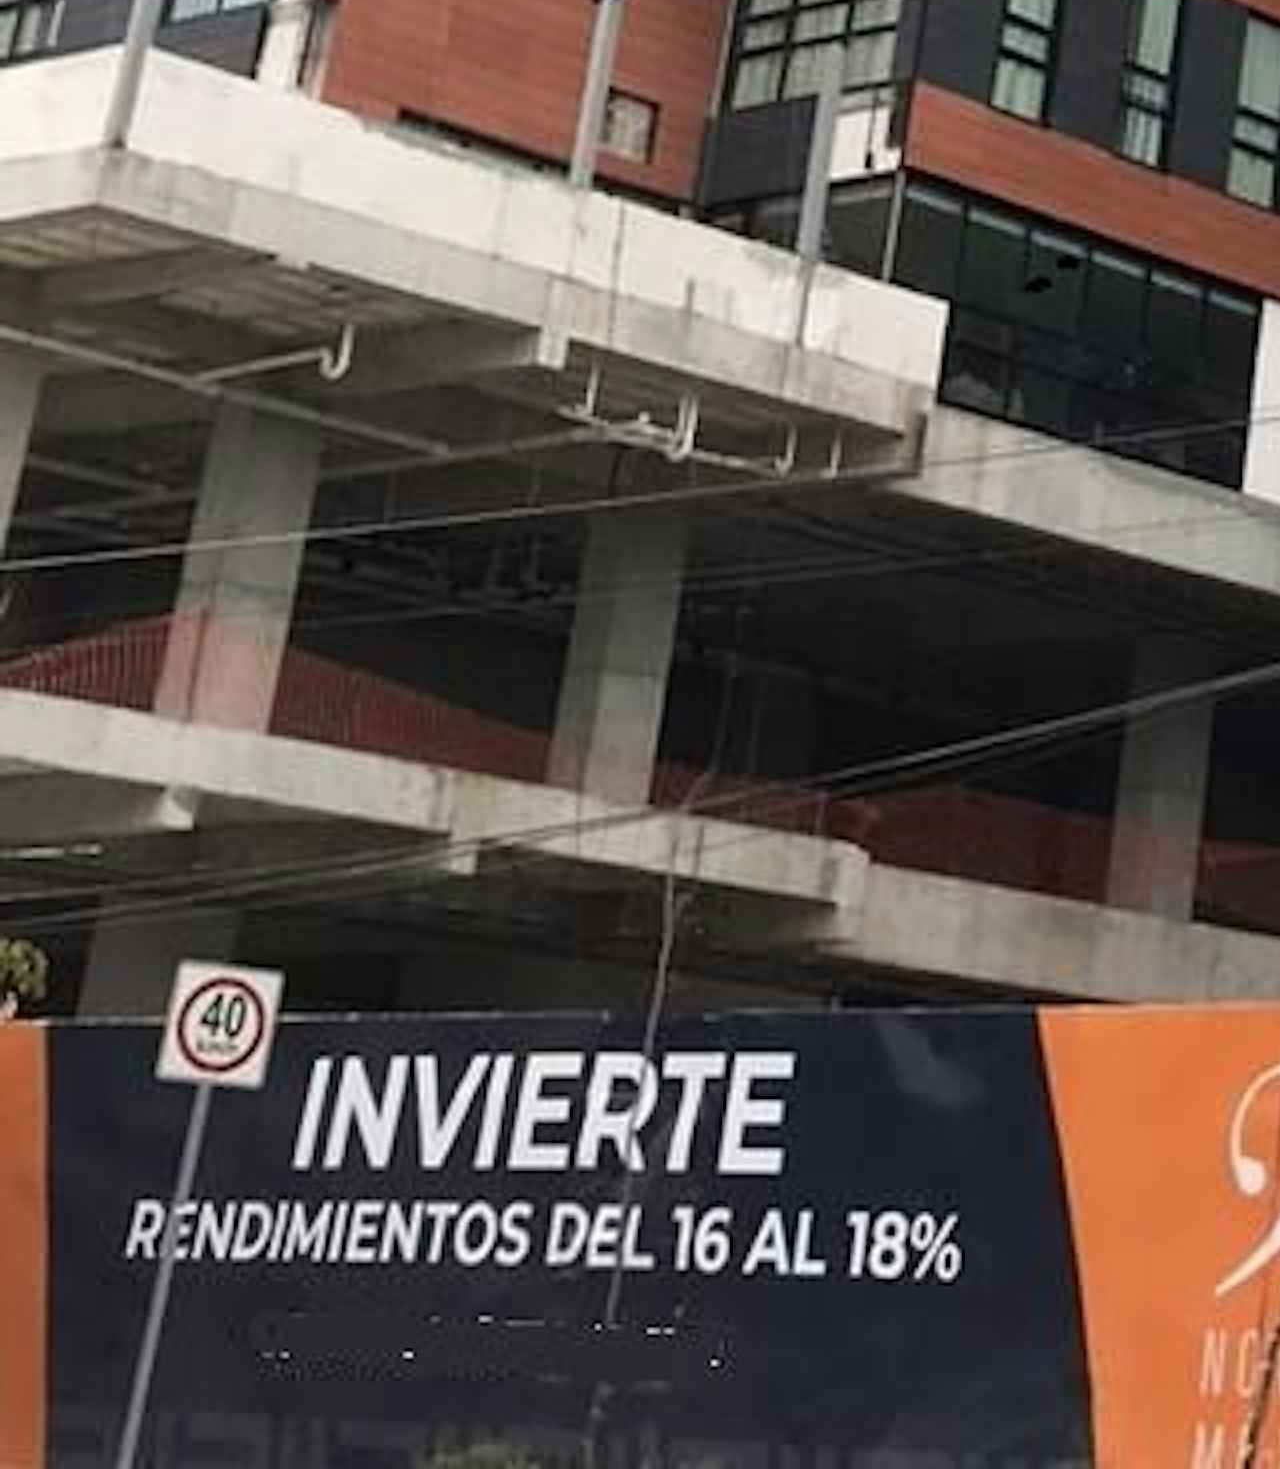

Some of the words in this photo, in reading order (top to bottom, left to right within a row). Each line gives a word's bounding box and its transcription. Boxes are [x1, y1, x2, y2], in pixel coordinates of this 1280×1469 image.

[200, 993, 247, 1038] 40
[293, 1051, 796, 1174] INVIERTE
[125, 1199, 535, 1266] RENDIMIENTOS
[545, 1202, 655, 1271] DEL
[671, 1205, 732, 1274] 16
[741, 1208, 827, 1276] AL
[846, 1210, 963, 1282] 18%
